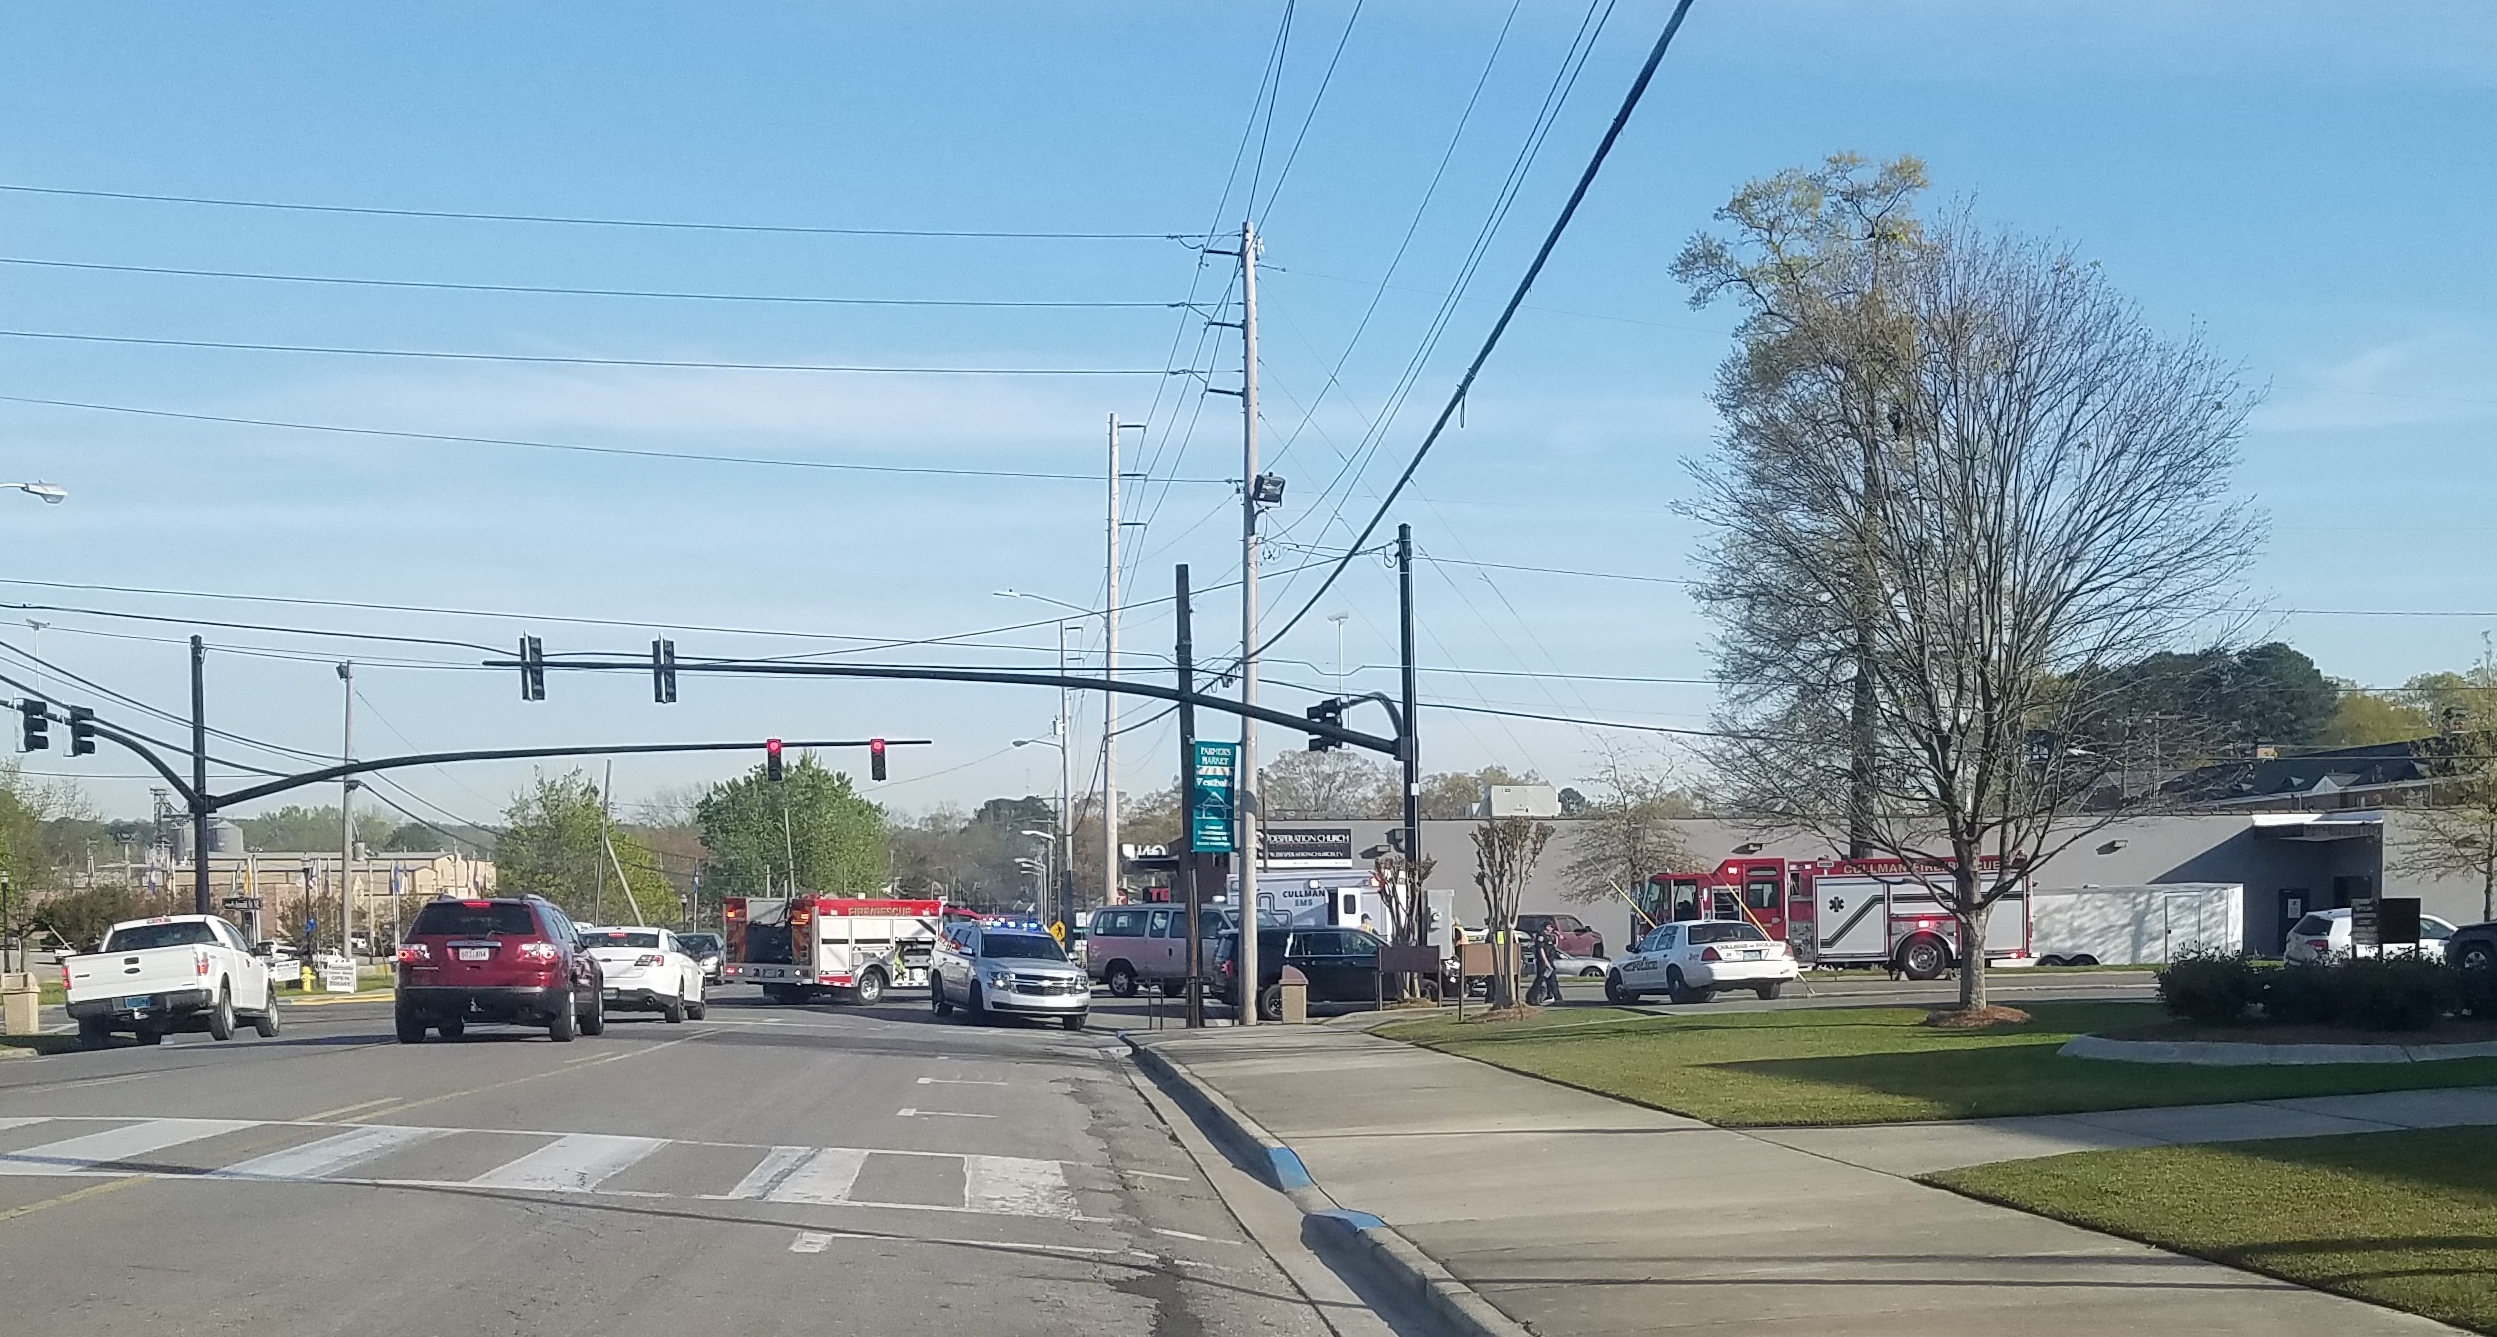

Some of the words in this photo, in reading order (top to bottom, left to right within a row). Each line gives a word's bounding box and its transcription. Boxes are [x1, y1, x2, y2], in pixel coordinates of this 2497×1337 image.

[1201, 756, 1230, 765] MARKET
[1317, 834, 1350, 843] CHURCH
[1282, 890, 1326, 898] CULLMAN
[1294, 899, 1313, 907] EMS
[1631, 960, 1658, 971] POLICE
